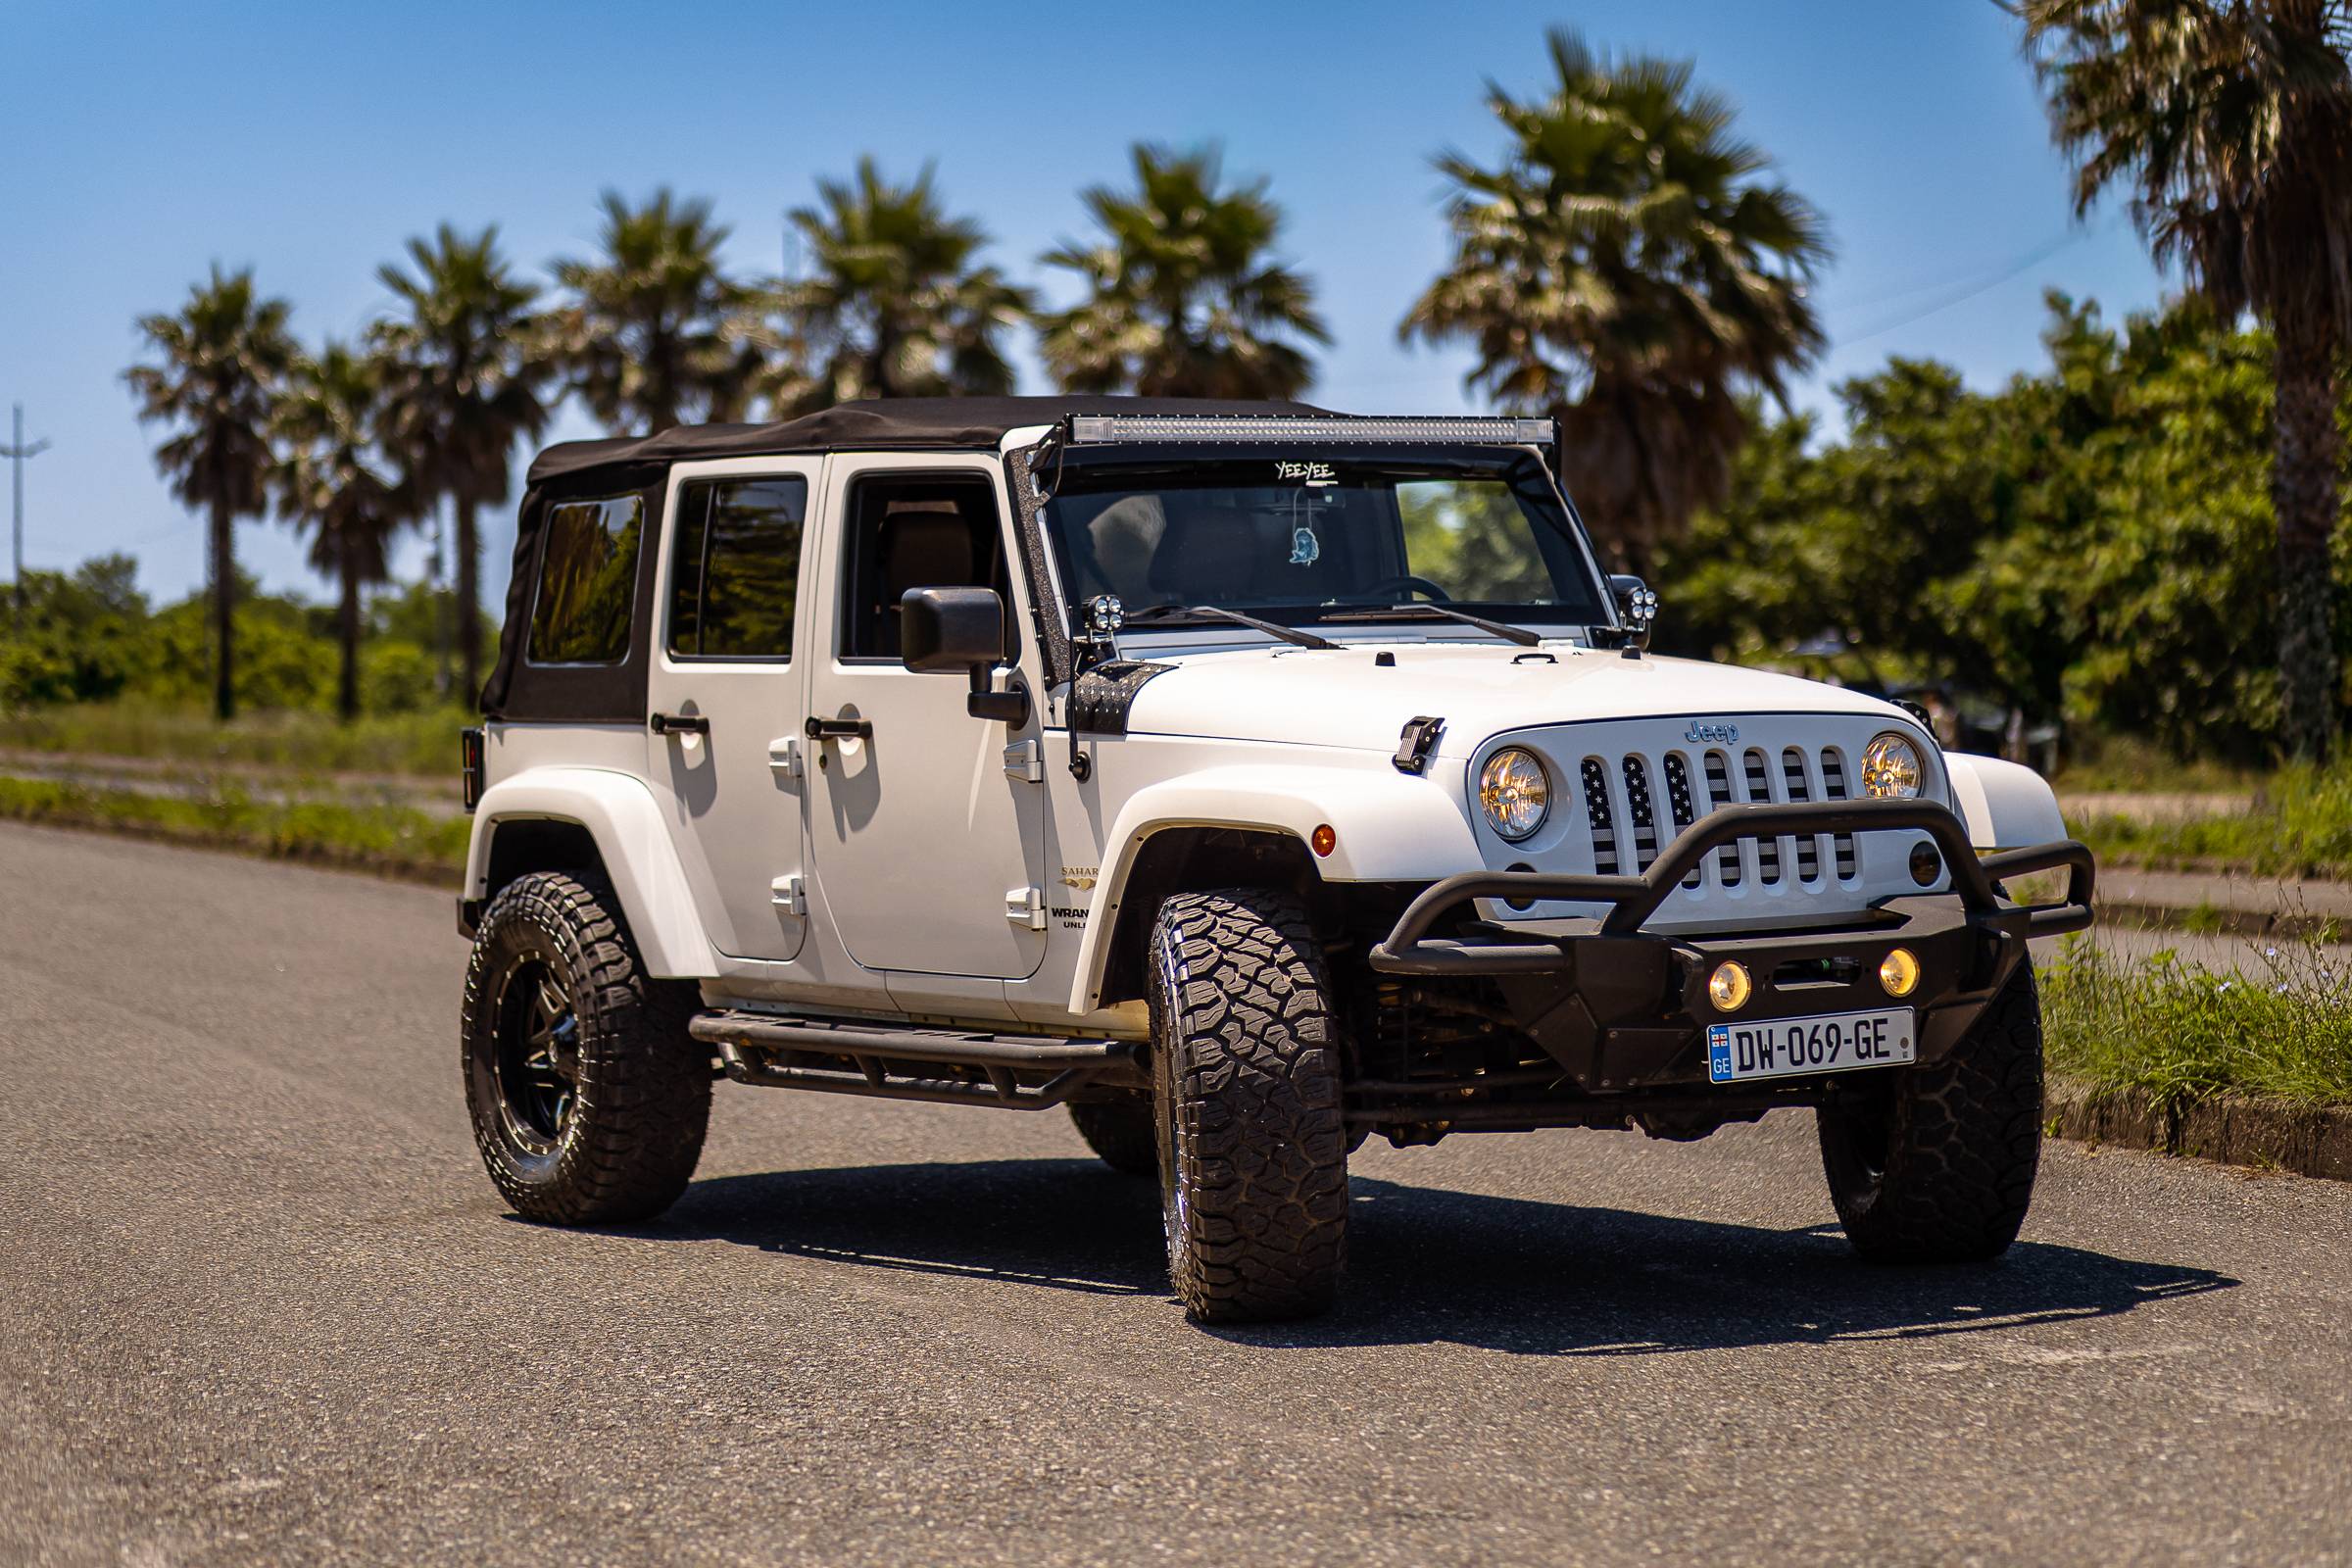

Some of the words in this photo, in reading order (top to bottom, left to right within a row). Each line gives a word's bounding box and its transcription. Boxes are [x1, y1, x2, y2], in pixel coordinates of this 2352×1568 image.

[1685, 720, 1740, 745] Jeep
[1061, 866, 1099, 876] SAHAR
[1052, 907, 1090, 918] WRAN
[1735, 1017, 1890, 1073] DW-069-GE
[1713, 1057, 1731, 1074] GE
